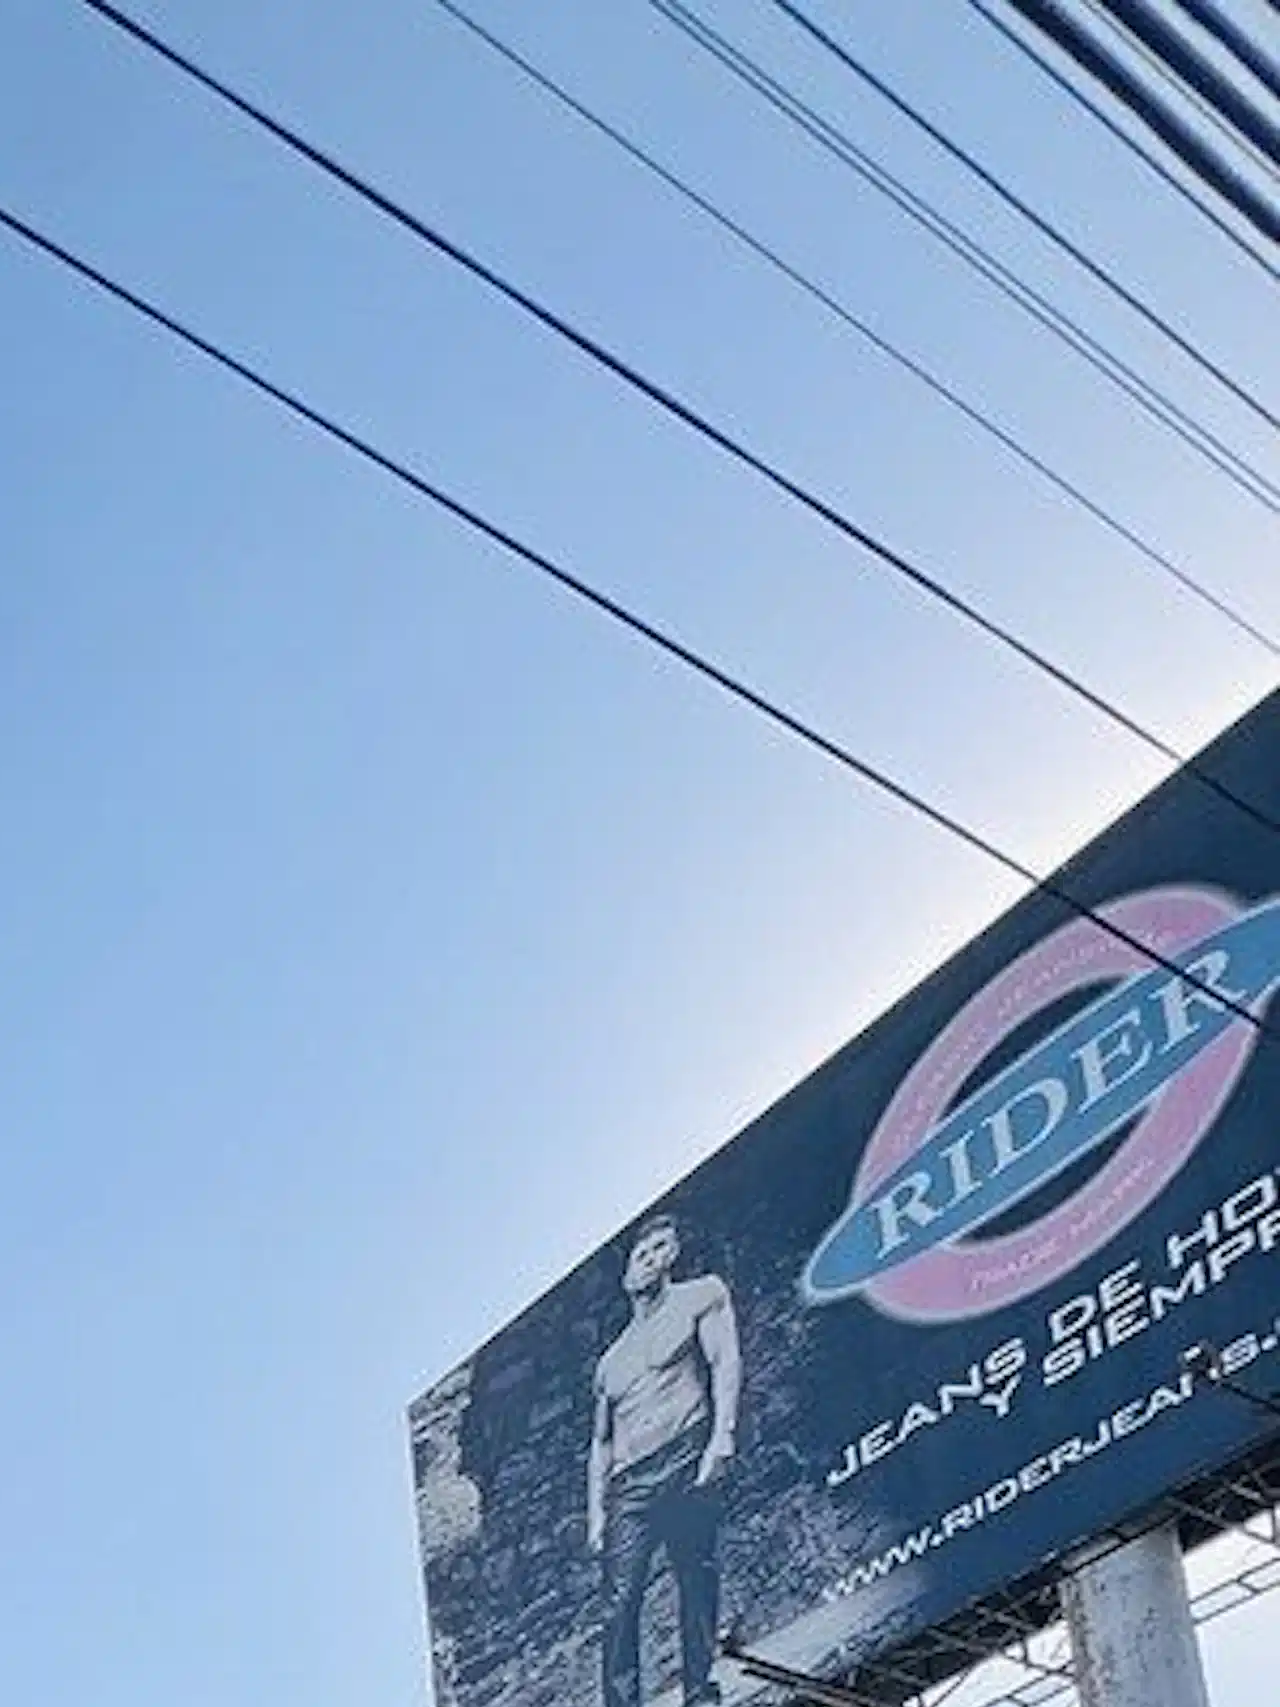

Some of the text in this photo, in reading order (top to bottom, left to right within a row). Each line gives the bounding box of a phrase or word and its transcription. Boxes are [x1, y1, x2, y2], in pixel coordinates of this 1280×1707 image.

[870, 949, 1249, 1260] RIDER
[821, 1317, 1280, 1602] WWW.RIDERJEAS.
[825, 1336, 1028, 1486] JEANS
[1048, 1260, 1142, 1343] DE
[1165, 1166, 1280, 1269] HO
[979, 1374, 1023, 1418] Y
